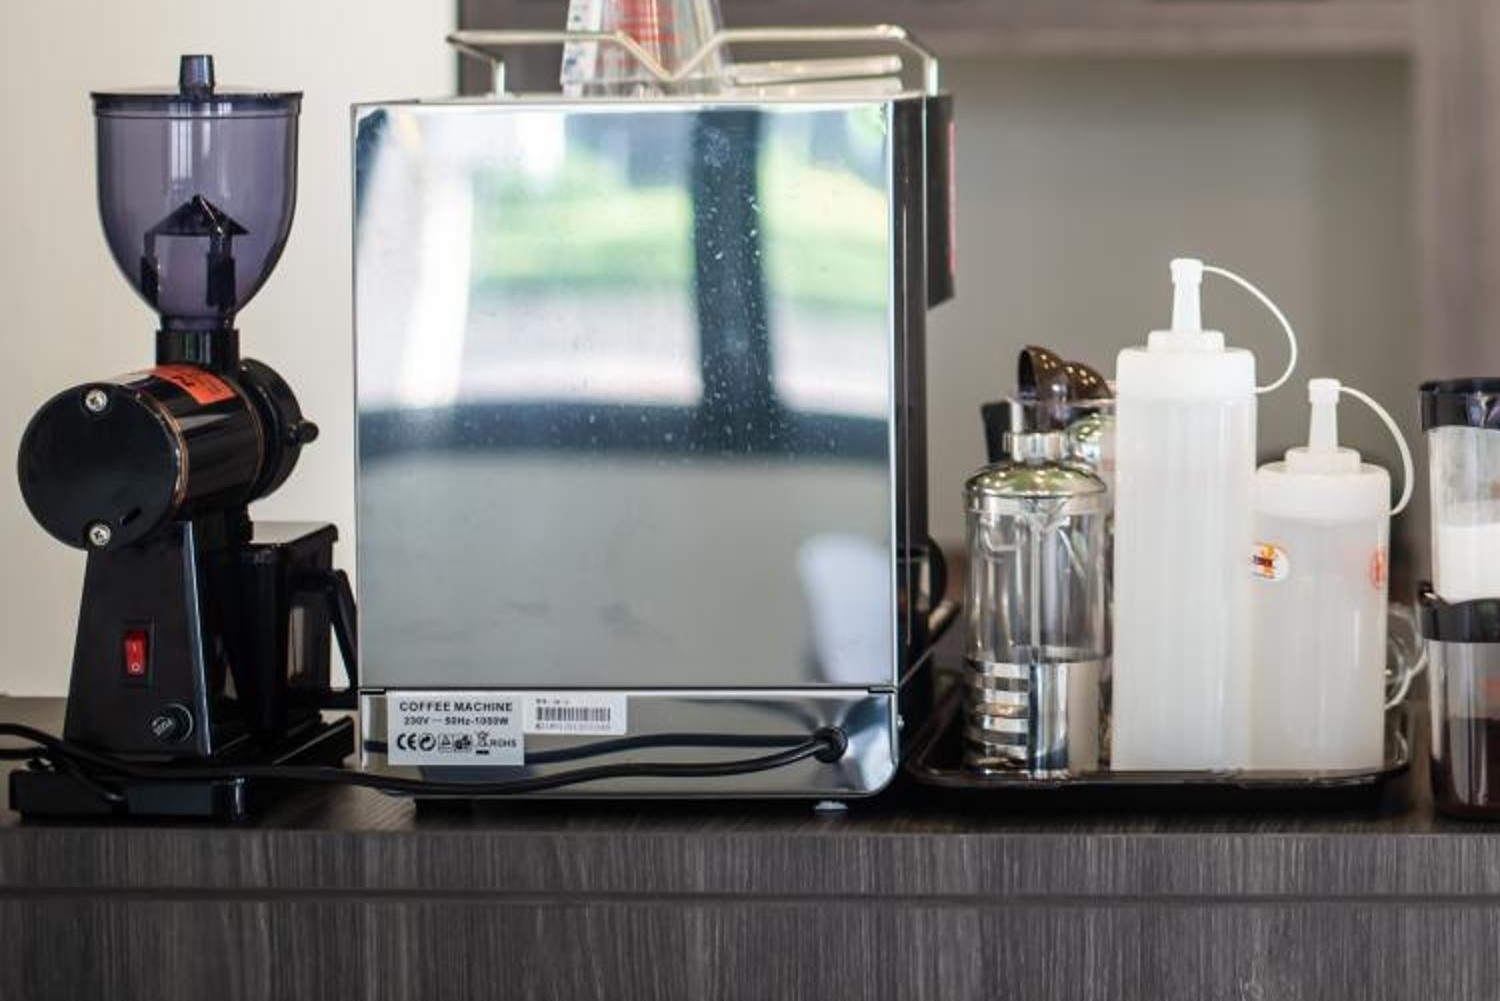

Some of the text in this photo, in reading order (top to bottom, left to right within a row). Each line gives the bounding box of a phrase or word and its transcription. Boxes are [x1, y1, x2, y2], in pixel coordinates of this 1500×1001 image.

[399, 701, 513, 712] COFFEE MACHINE
[403, 716, 430, 726] 230V
